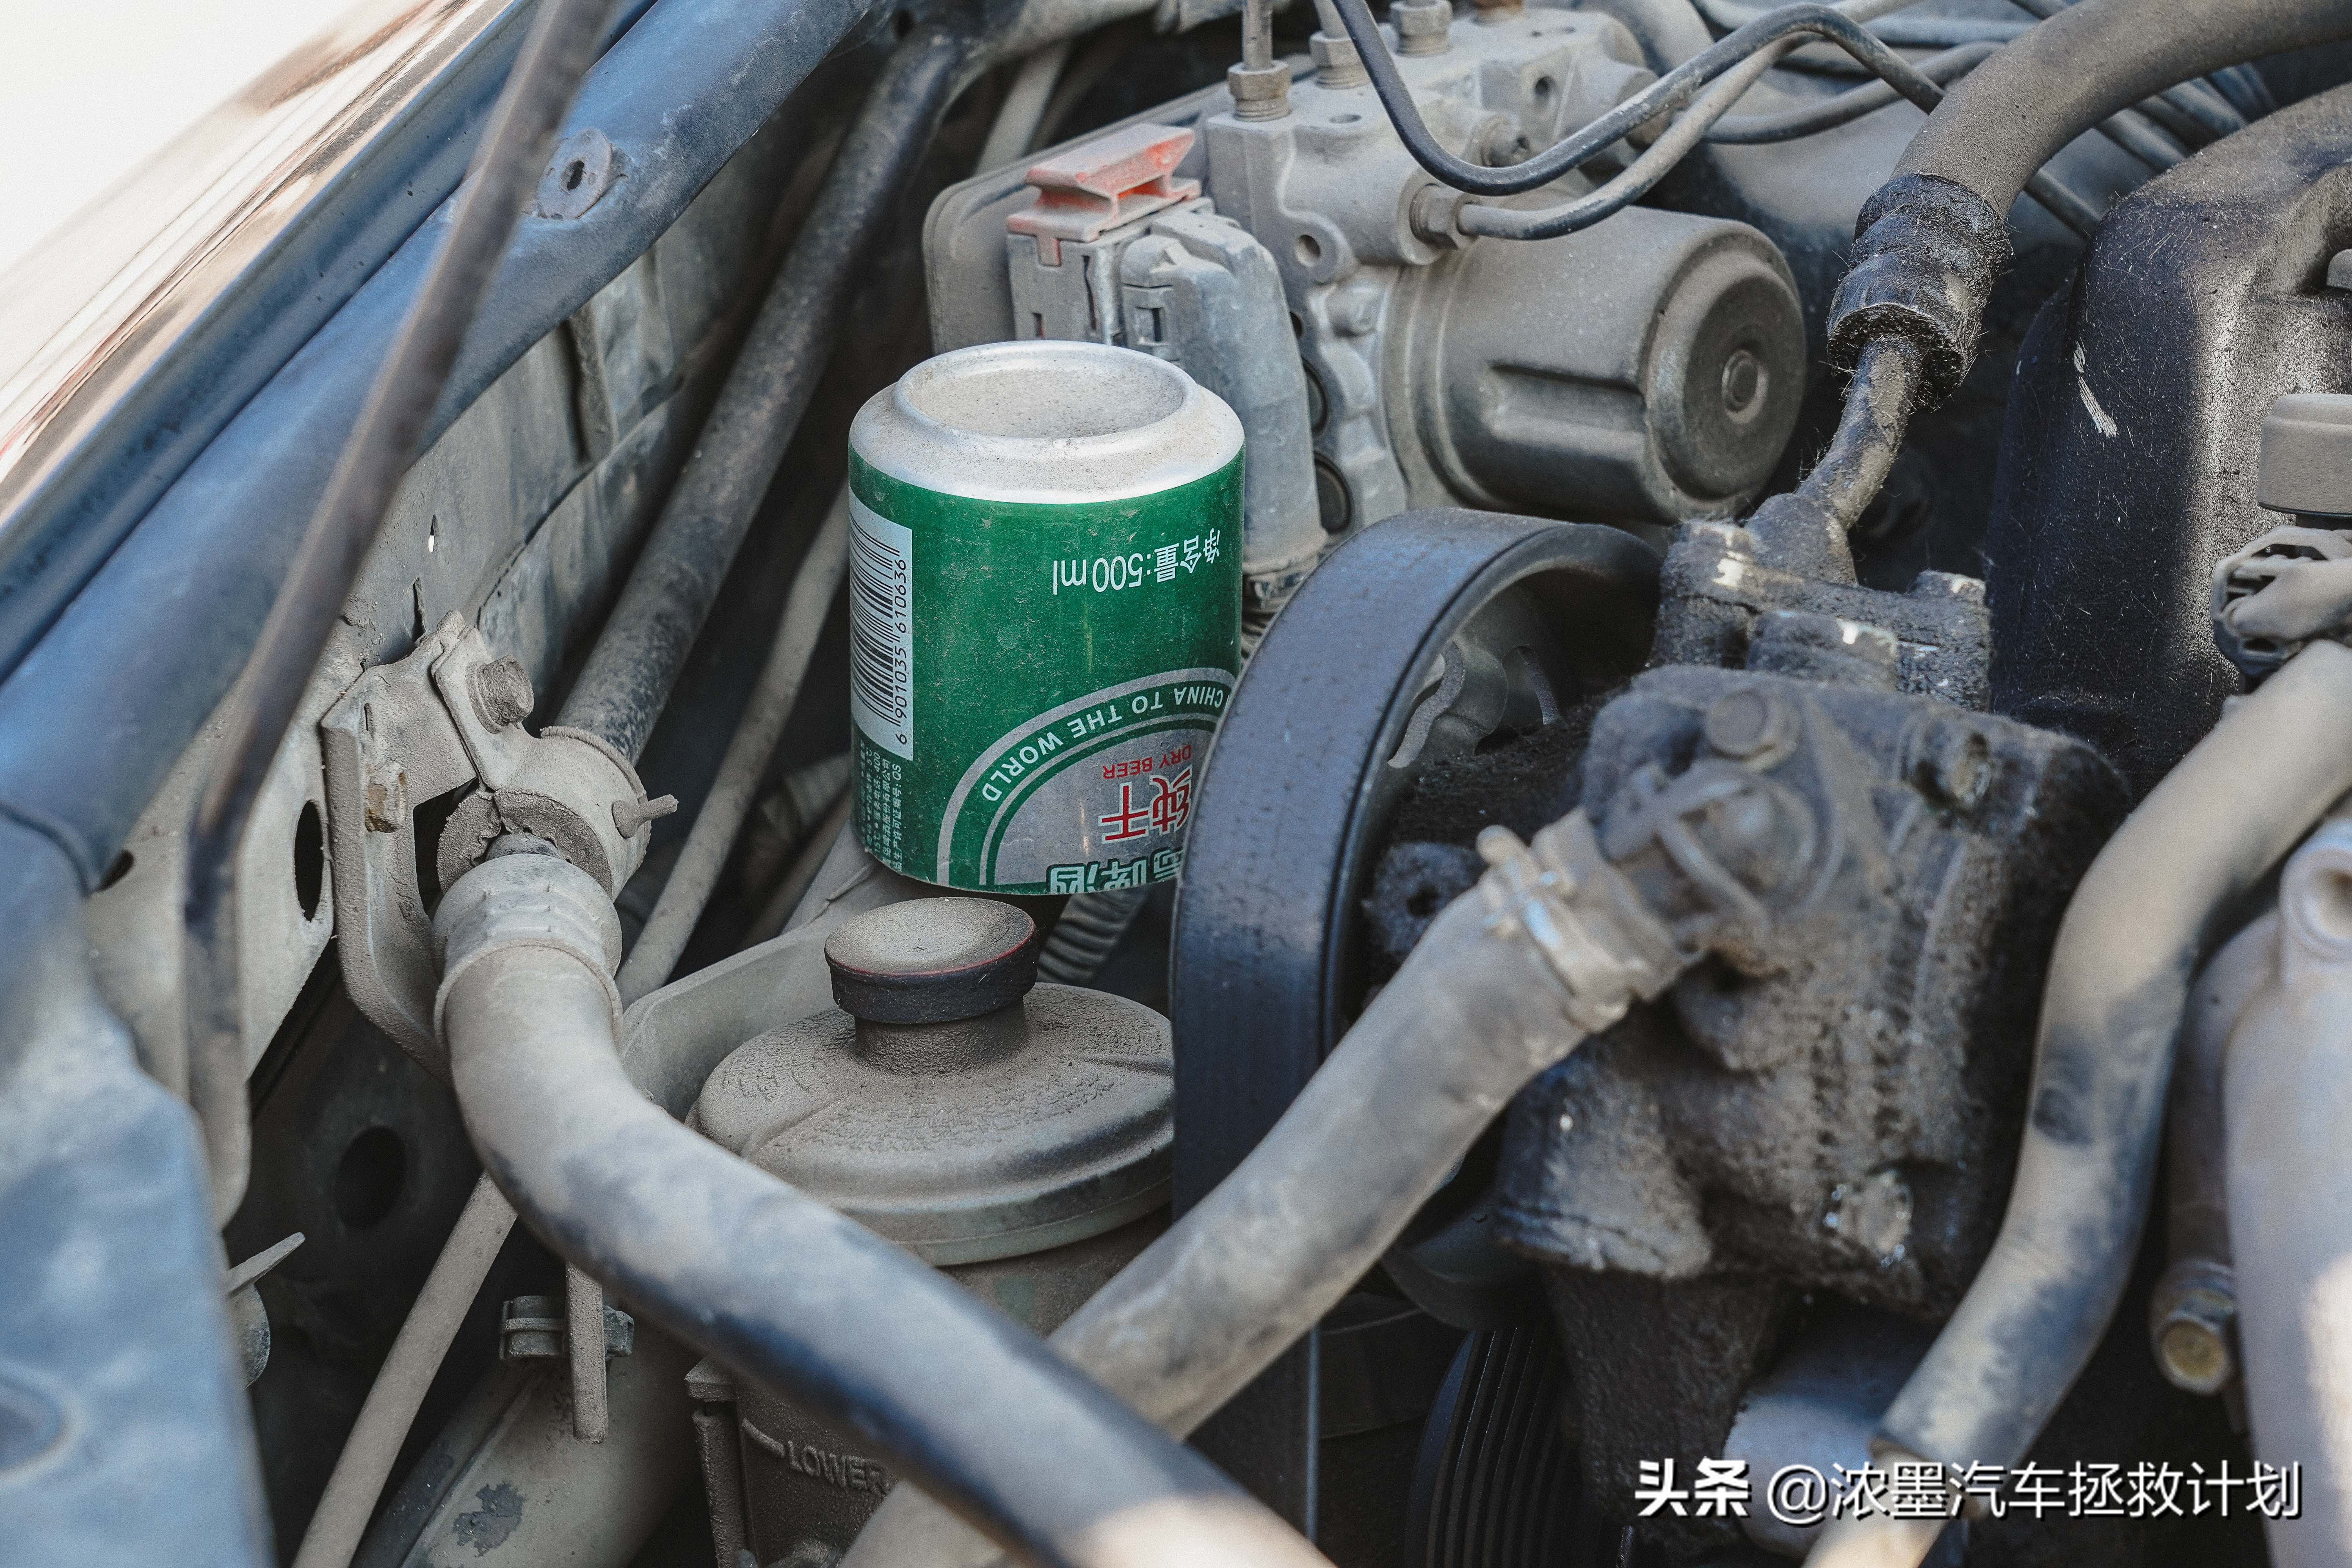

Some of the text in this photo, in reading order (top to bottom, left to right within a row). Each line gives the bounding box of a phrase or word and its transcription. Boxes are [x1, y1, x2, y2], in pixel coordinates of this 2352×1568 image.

[894, 559, 907, 745] 6 901035 610636
[1132, 691, 1163, 713] TO
[1173, 686, 1224, 708] CHINA
[1067, 708, 1122, 739] THE
[982, 737, 1062, 802] WORLD
[1102, 745, 1192, 779] DRY BEER
[1098, 767, 1192, 843] 纯干
[787, 1440, 891, 1497] LOWER
